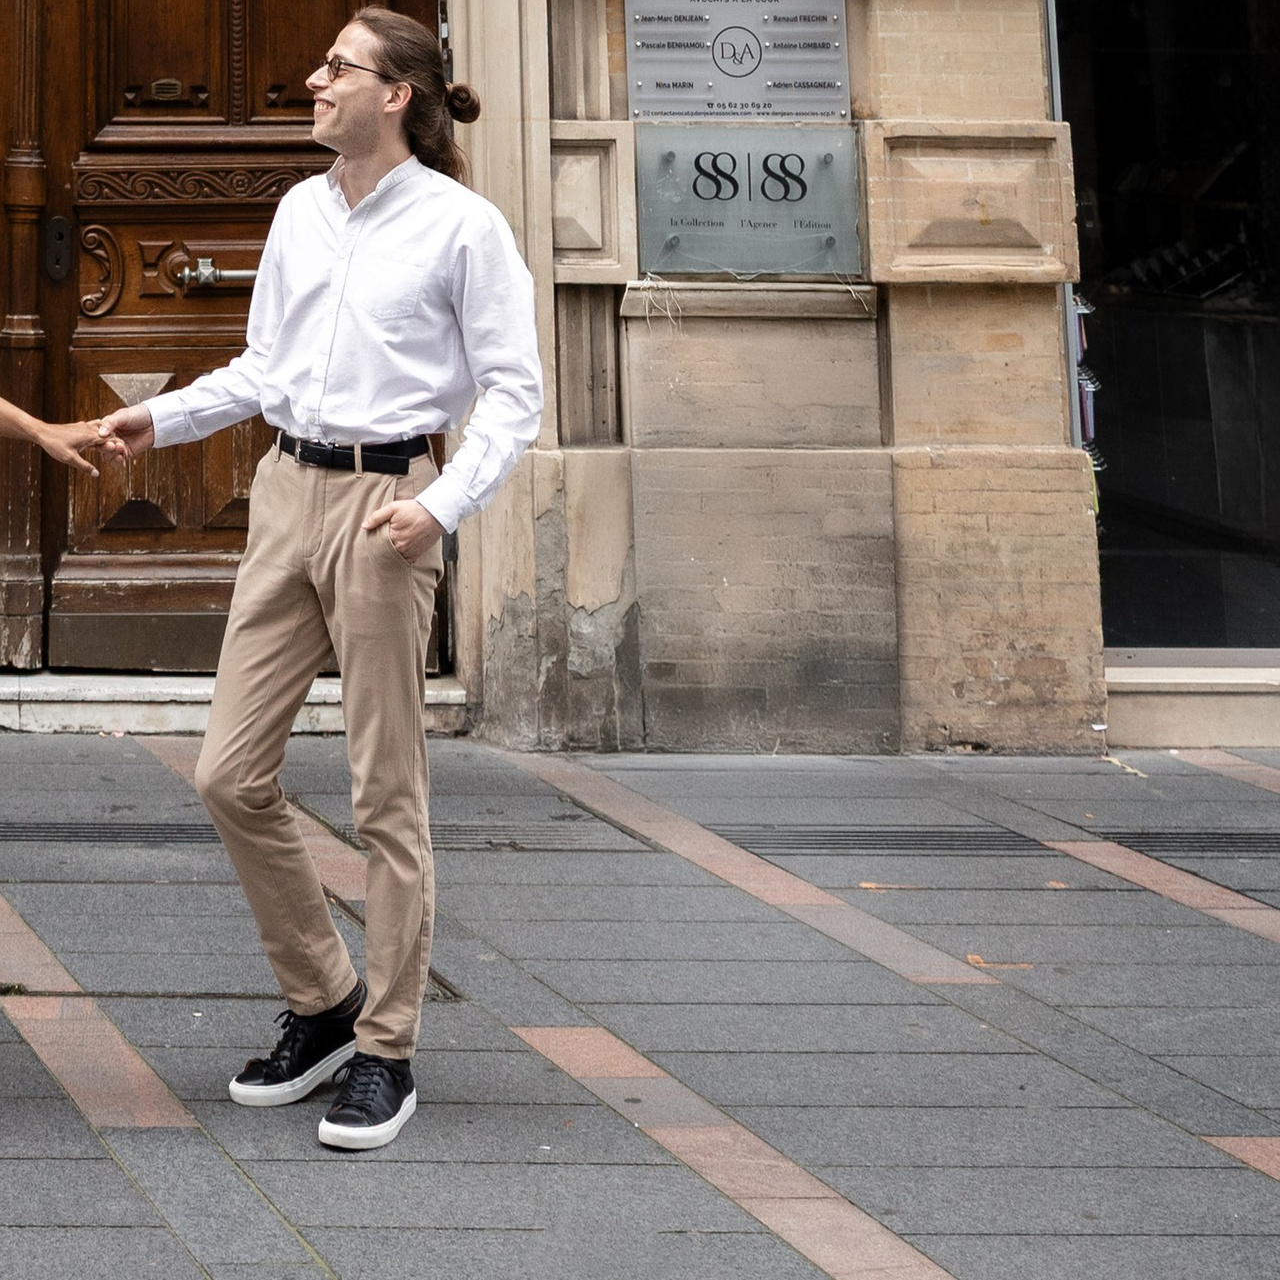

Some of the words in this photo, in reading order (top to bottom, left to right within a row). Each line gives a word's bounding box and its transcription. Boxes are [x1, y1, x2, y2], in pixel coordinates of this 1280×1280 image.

[773, 42, 798, 50] Antoine
[798, 42, 831, 50] LOMBARD
[728, 101, 738, 109] 62
[670, 217, 678, 227] la
[680, 218, 725, 227] Collection
[740, 218, 778, 230] l'Agence
[793, 218, 832, 229] l'Édition
